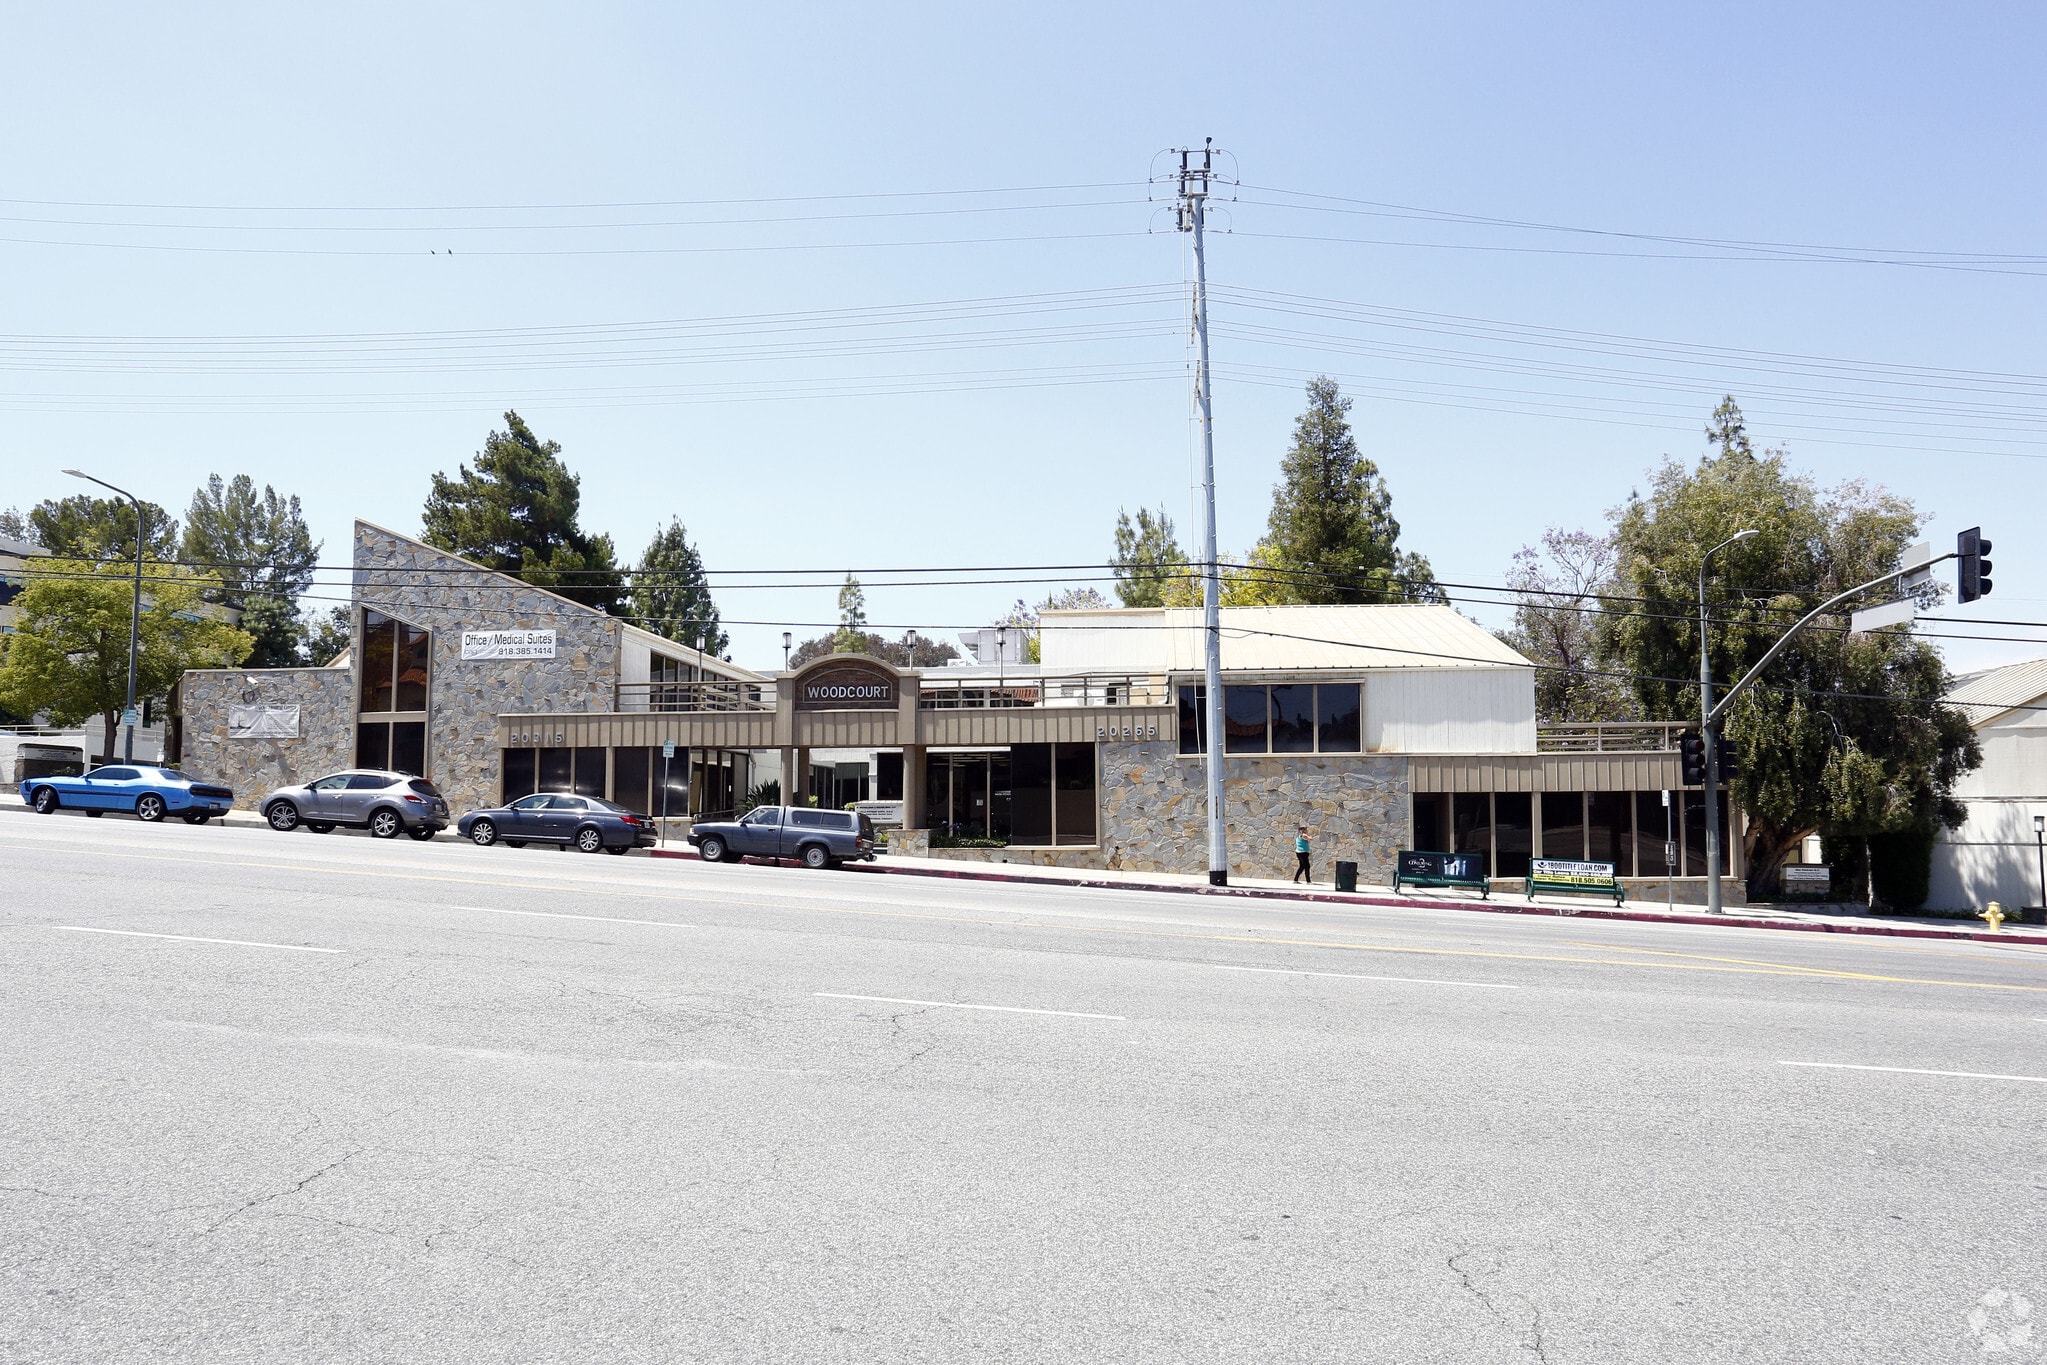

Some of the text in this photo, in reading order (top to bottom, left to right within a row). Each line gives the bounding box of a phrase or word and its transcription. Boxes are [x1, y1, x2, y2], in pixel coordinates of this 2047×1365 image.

[465, 634, 487, 646] Office
[494, 634, 525, 645] Medical
[527, 633, 553, 645] Suites
[498, 647, 552, 655] 818.385.1414
[808, 686, 889, 699] WOODCOURT
[1097, 725, 1156, 737] 20265
[511, 732, 563, 743] 20315
